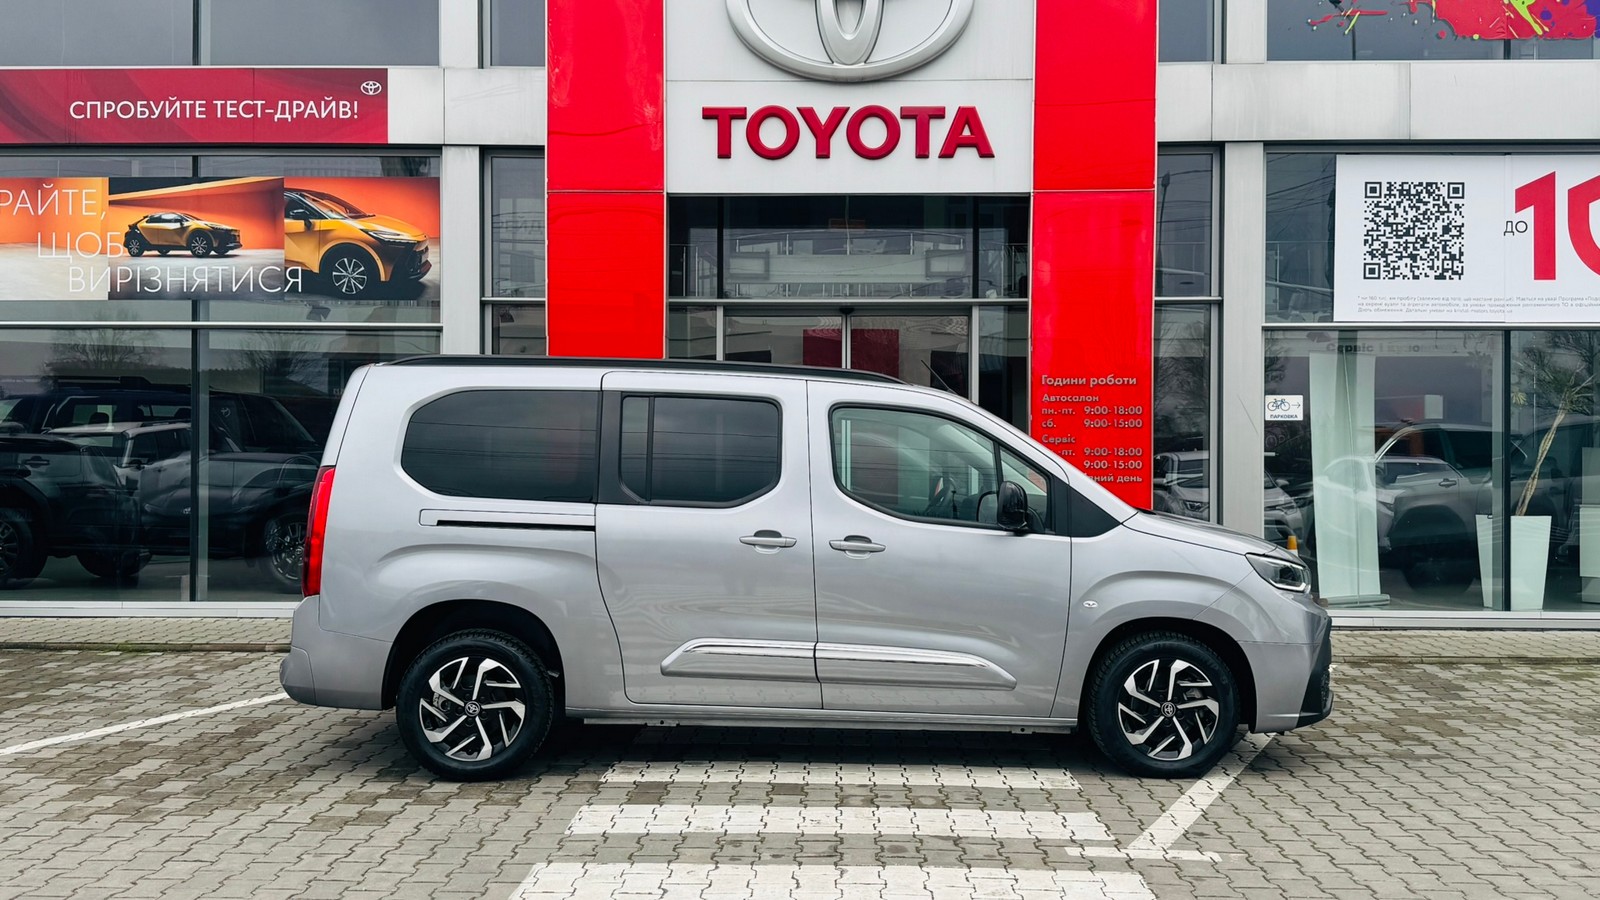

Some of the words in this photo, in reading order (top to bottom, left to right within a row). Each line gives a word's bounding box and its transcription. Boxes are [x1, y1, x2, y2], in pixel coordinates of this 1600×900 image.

[70, 96, 206, 119] СПРОБУЙТЕ
[213, 96, 359, 122] ТЕСТ-ДРАЙВ!
[702, 105, 995, 160] TOYOTA
[37, 231, 125, 264] ЩОБ
[69, 266, 302, 293] ВИРІЗНЯТИСЯ
[1042, 374, 1086, 386] Години
[1089, 374, 1137, 387] роботи
[1042, 393, 1099, 402] Автосалон
[1042, 419, 1057, 428] сб.
[1042, 434, 1076, 444] Сервіс
[1116, 475, 1143, 483] день
